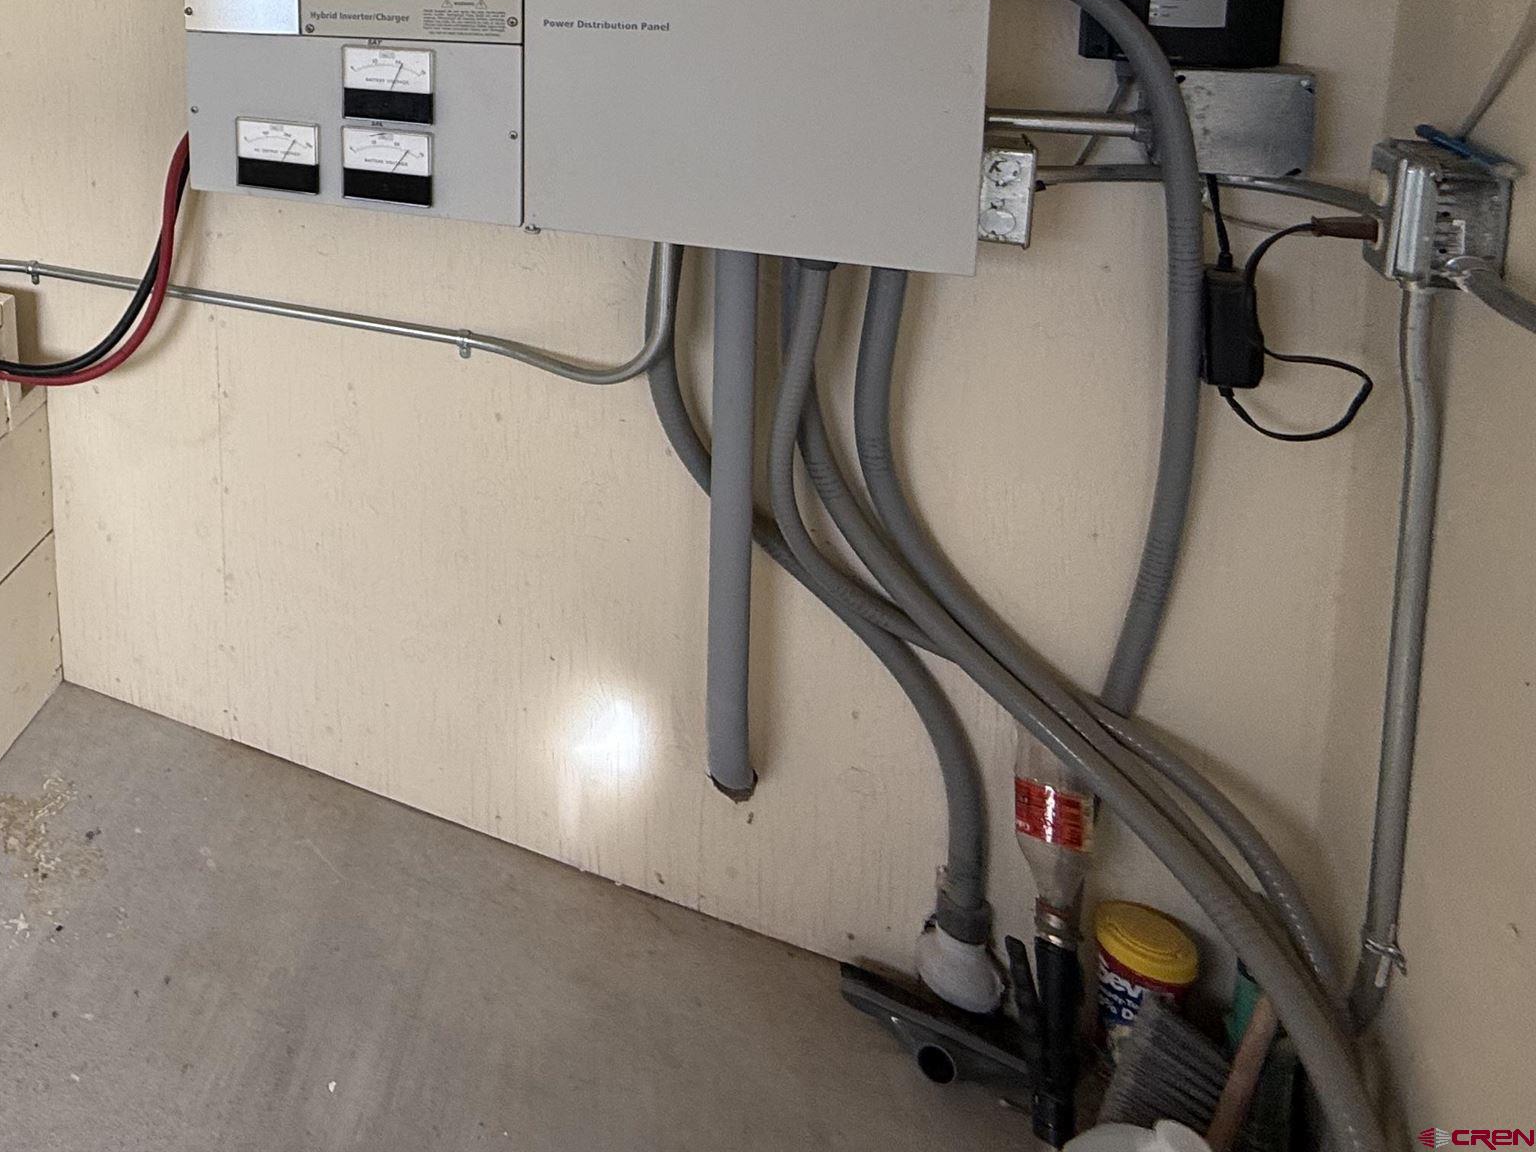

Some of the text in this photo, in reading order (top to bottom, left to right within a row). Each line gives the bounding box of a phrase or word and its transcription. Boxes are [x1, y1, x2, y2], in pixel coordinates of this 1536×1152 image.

[310, 11, 338, 21] Hybrid
[543, 18, 671, 32] Power Distribution Panel
